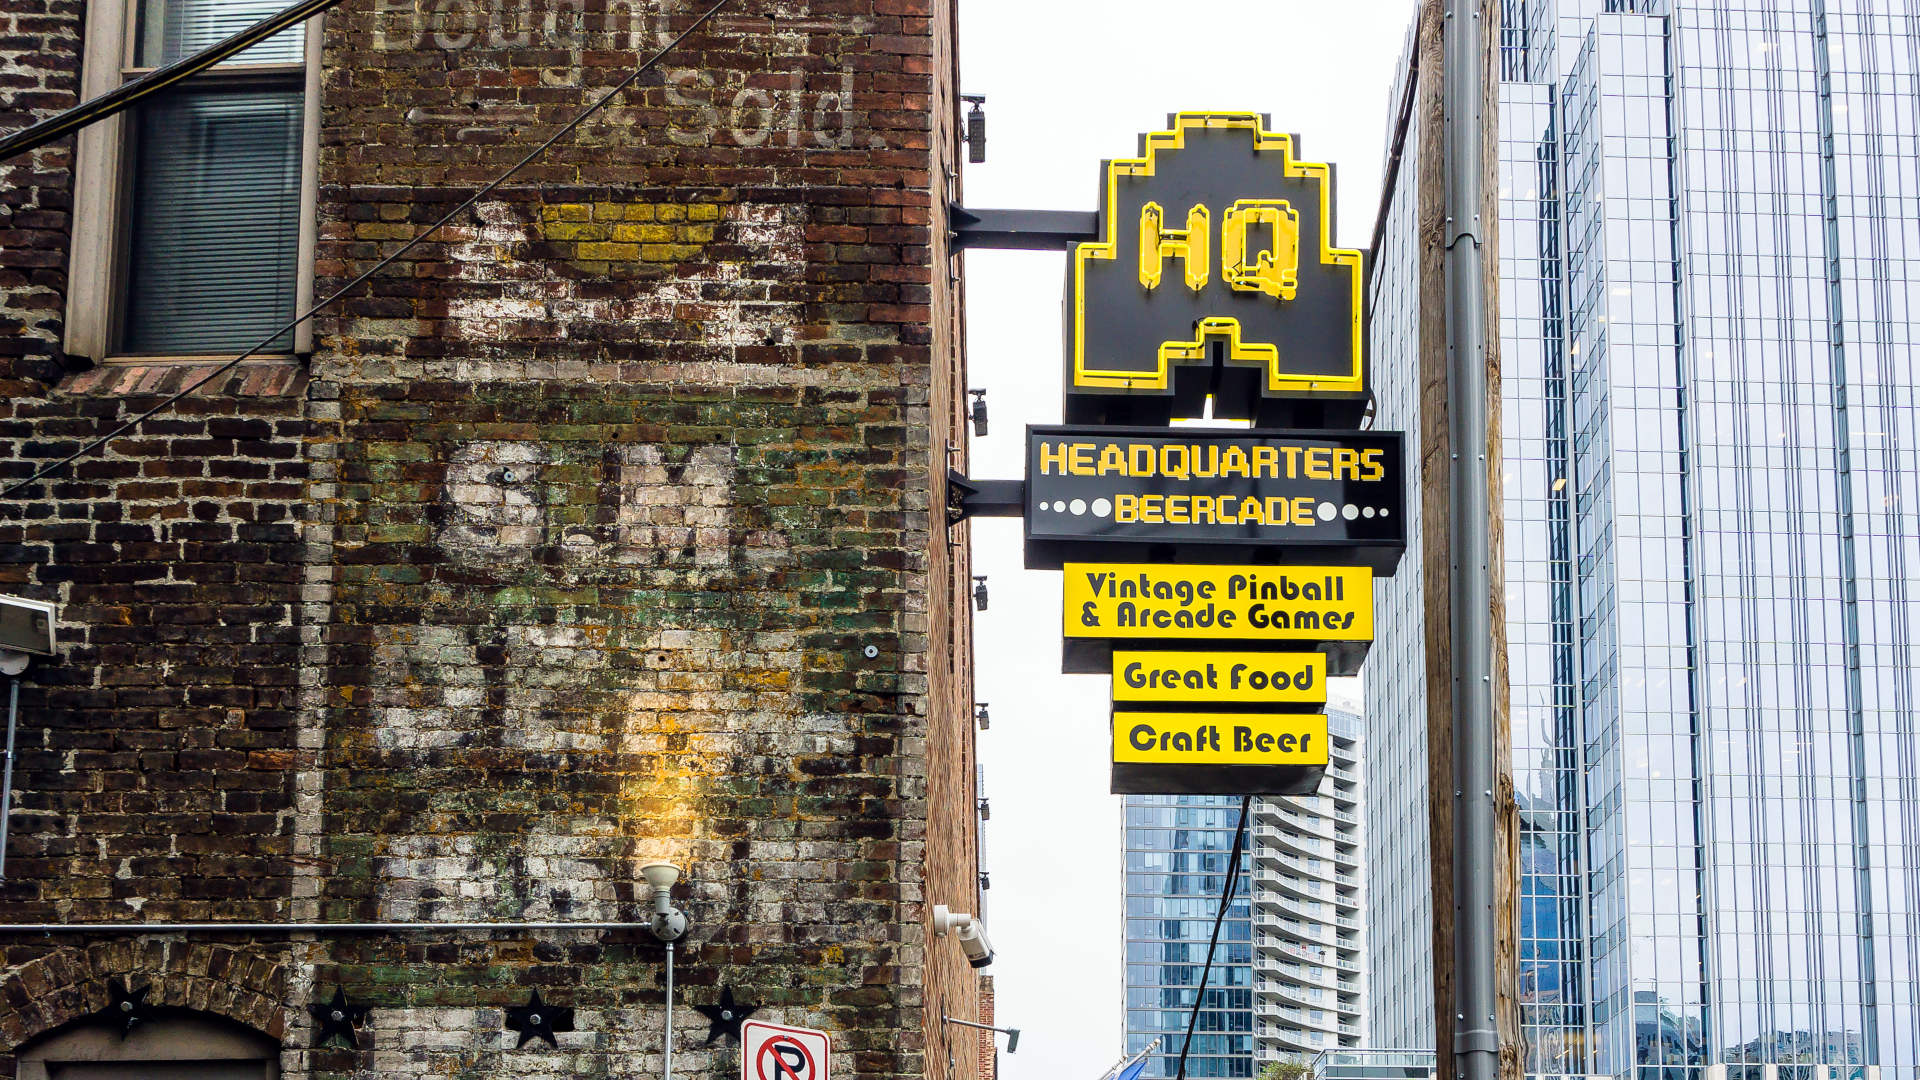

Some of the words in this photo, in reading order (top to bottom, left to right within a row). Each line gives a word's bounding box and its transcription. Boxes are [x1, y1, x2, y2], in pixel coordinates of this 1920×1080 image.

[1139, 199, 1299, 300] HQ
[1040, 441, 1385, 481] HEADQUARTERS
[1114, 494, 1316, 526] BEERCADE
[1086, 572, 1216, 606] Vintage
[1228, 575, 1343, 601] Pinball
[1080, 602, 1101, 627] &
[1117, 603, 1237, 629] Arcade
[1248, 603, 1355, 630] Games
[1124, 662, 1218, 689] Great
[1230, 663, 1313, 691] Food
[1128, 724, 1220, 753] Craft
[1233, 726, 1311, 753] Beer
